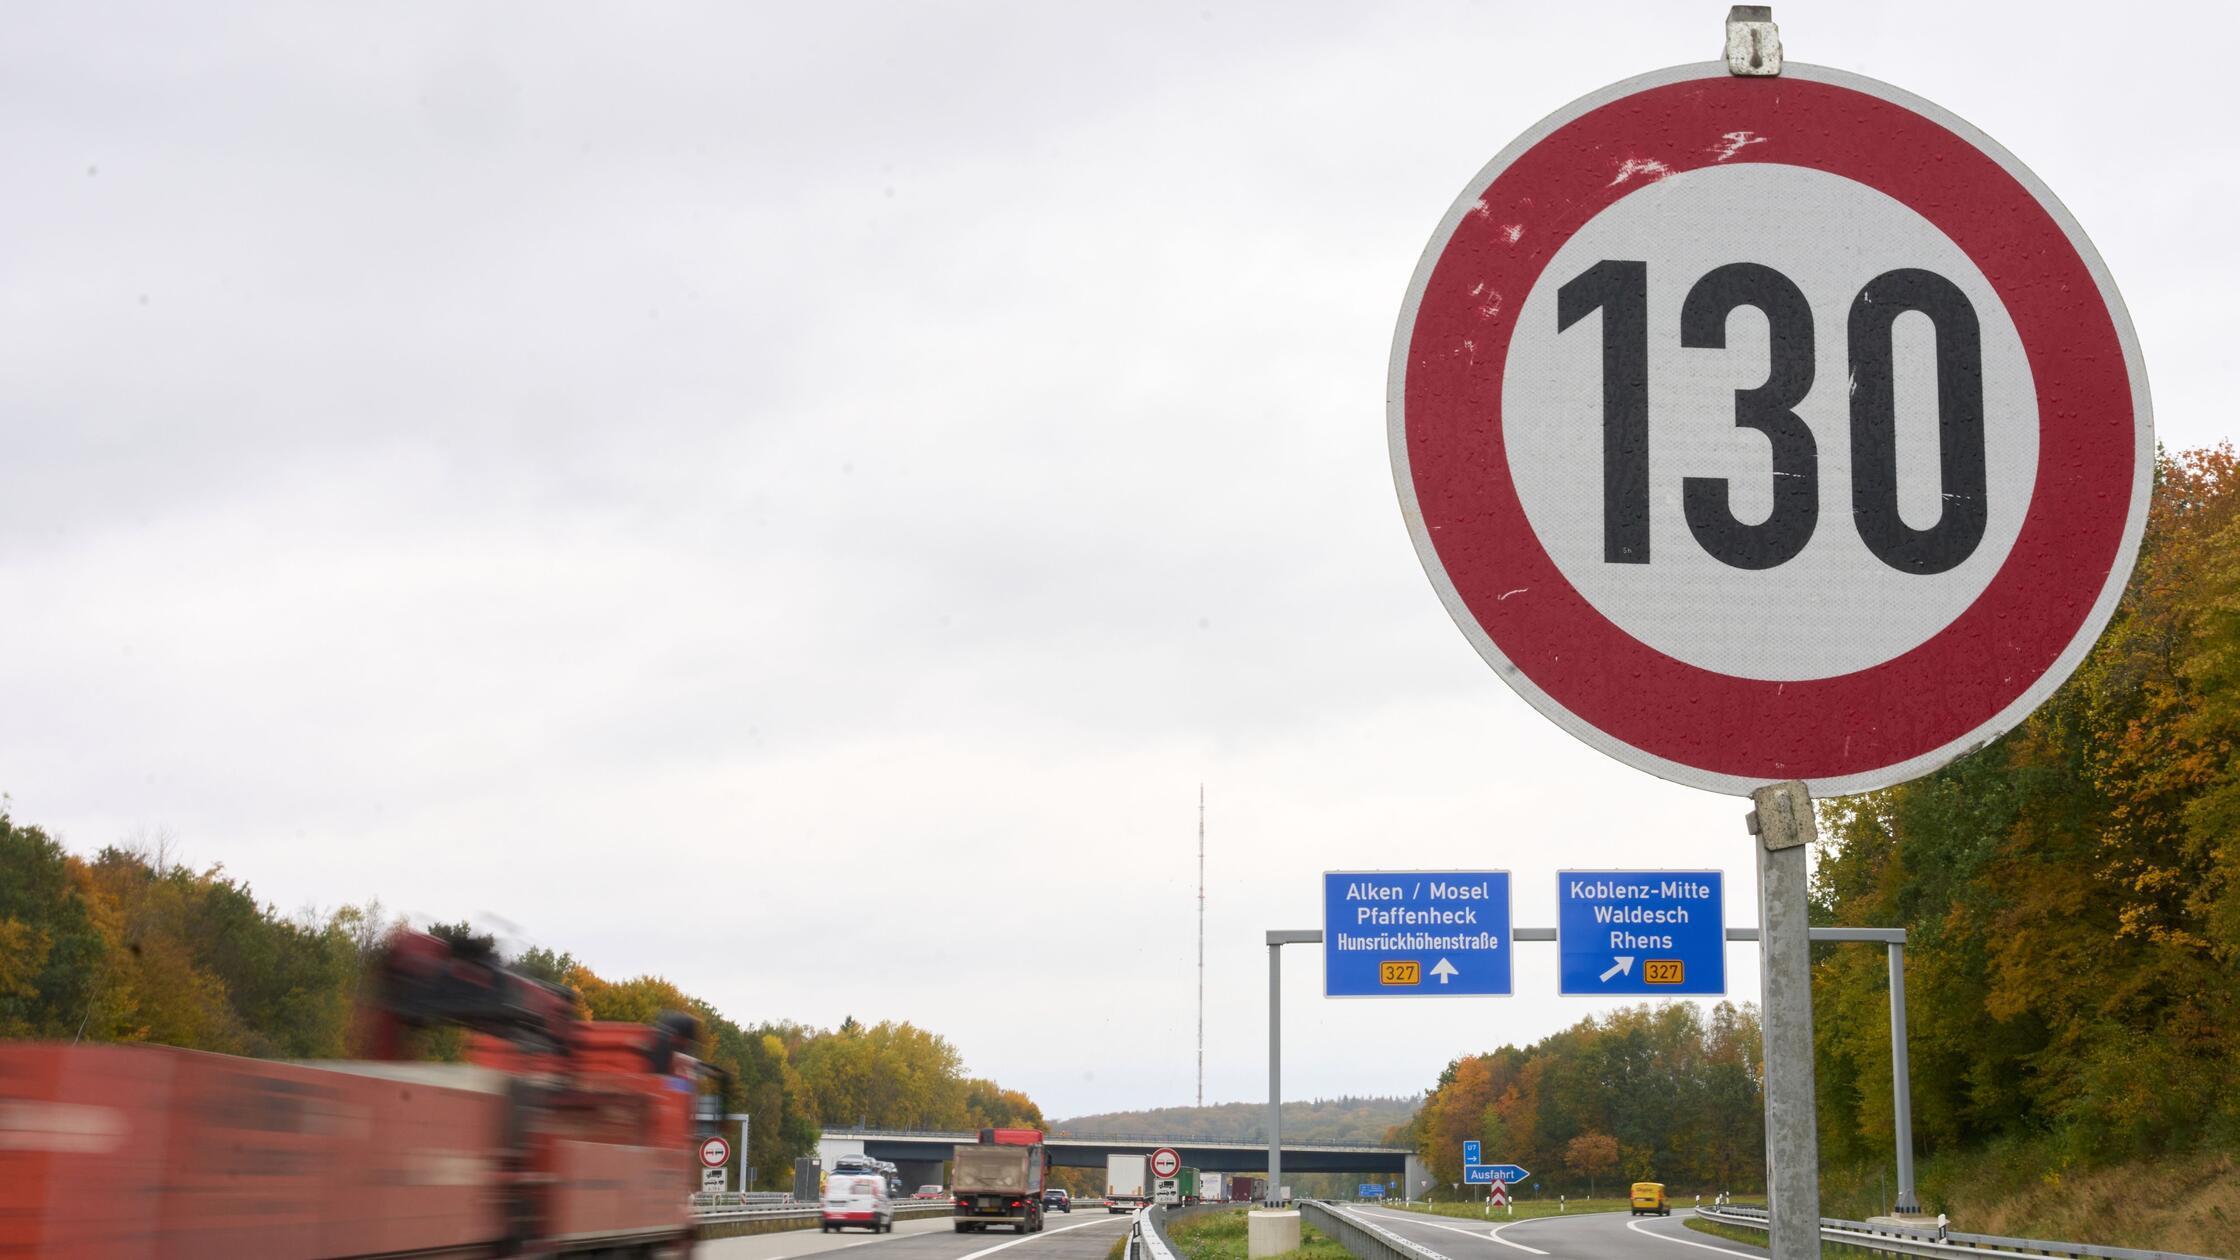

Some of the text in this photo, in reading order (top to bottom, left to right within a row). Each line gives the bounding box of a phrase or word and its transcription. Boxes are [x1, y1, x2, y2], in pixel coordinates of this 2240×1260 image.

[1557, 259, 1988, 576] 130
[1346, 881, 1489, 901] Alken / Mosel
[1570, 880, 1711, 900] Koblenz-Mitte
[1357, 906, 1477, 925] Pfaffenheck
[1593, 905, 1689, 924] Waldesch
[1337, 932, 1498, 951] Hunsrückhöhenstraße
[1610, 931, 1673, 949] Rhens
[1385, 965, 1416, 981] 327
[1649, 964, 1679, 980] 327
[1470, 1169, 1515, 1180] Ausfahrt
